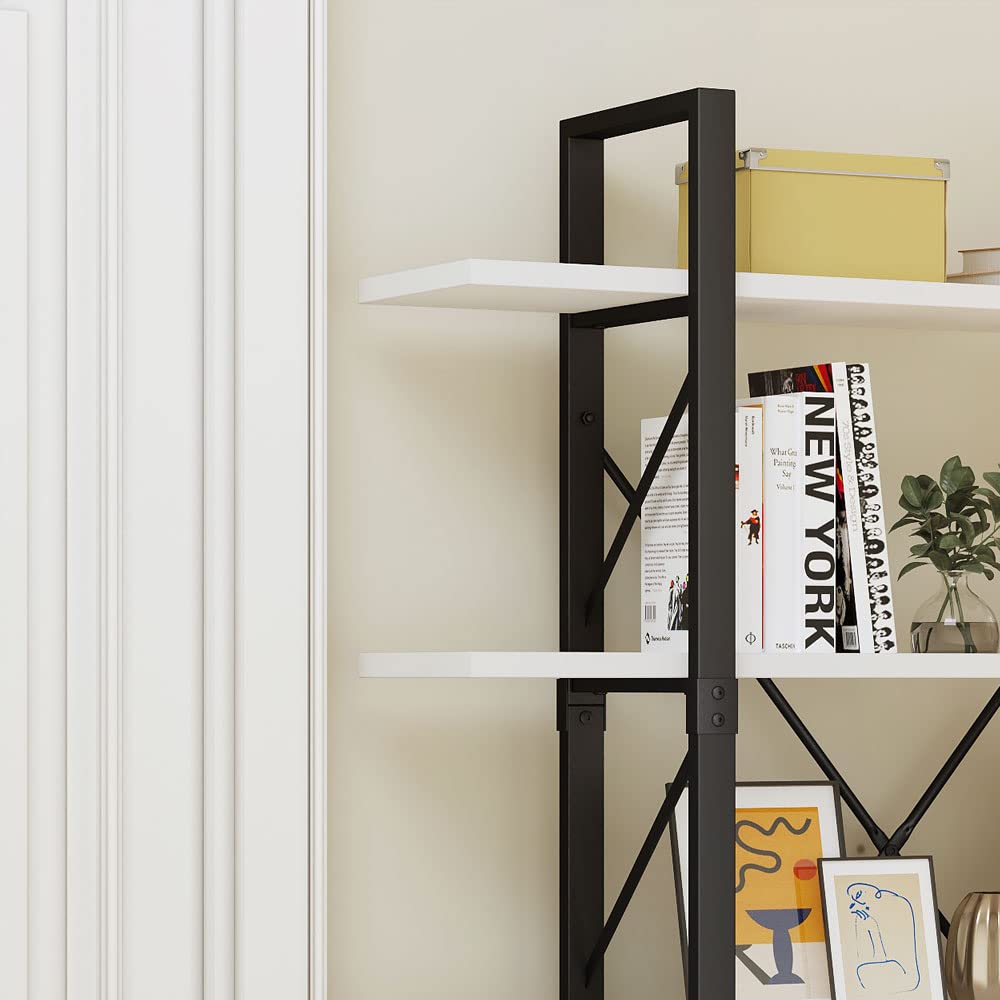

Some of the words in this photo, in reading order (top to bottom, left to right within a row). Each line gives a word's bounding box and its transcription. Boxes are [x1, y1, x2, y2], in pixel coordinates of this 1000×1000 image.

[769, 447, 787, 457] What
[782, 470, 792, 479] Say
[804, 396, 835, 504] NEW
[804, 518, 835, 650] YORK
